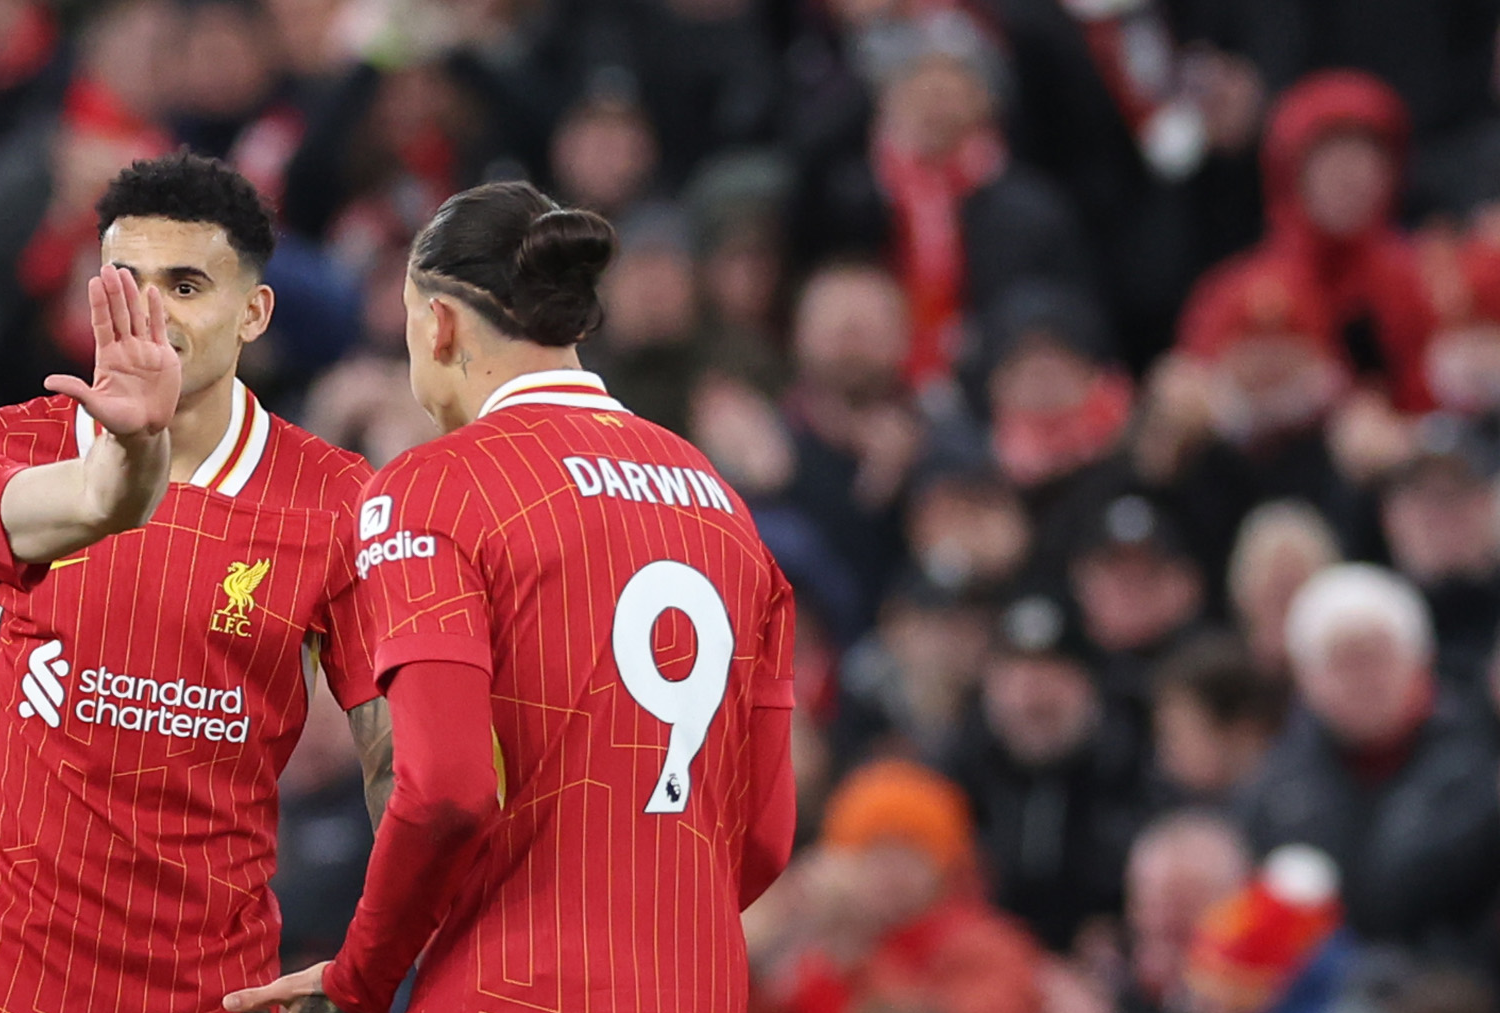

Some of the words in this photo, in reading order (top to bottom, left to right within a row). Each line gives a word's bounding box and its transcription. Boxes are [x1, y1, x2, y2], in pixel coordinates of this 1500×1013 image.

[563, 456, 733, 514] DARWIN
[79, 666, 242, 714] standard
[612, 560, 734, 813] 9
[75, 697, 249, 743] chartered
